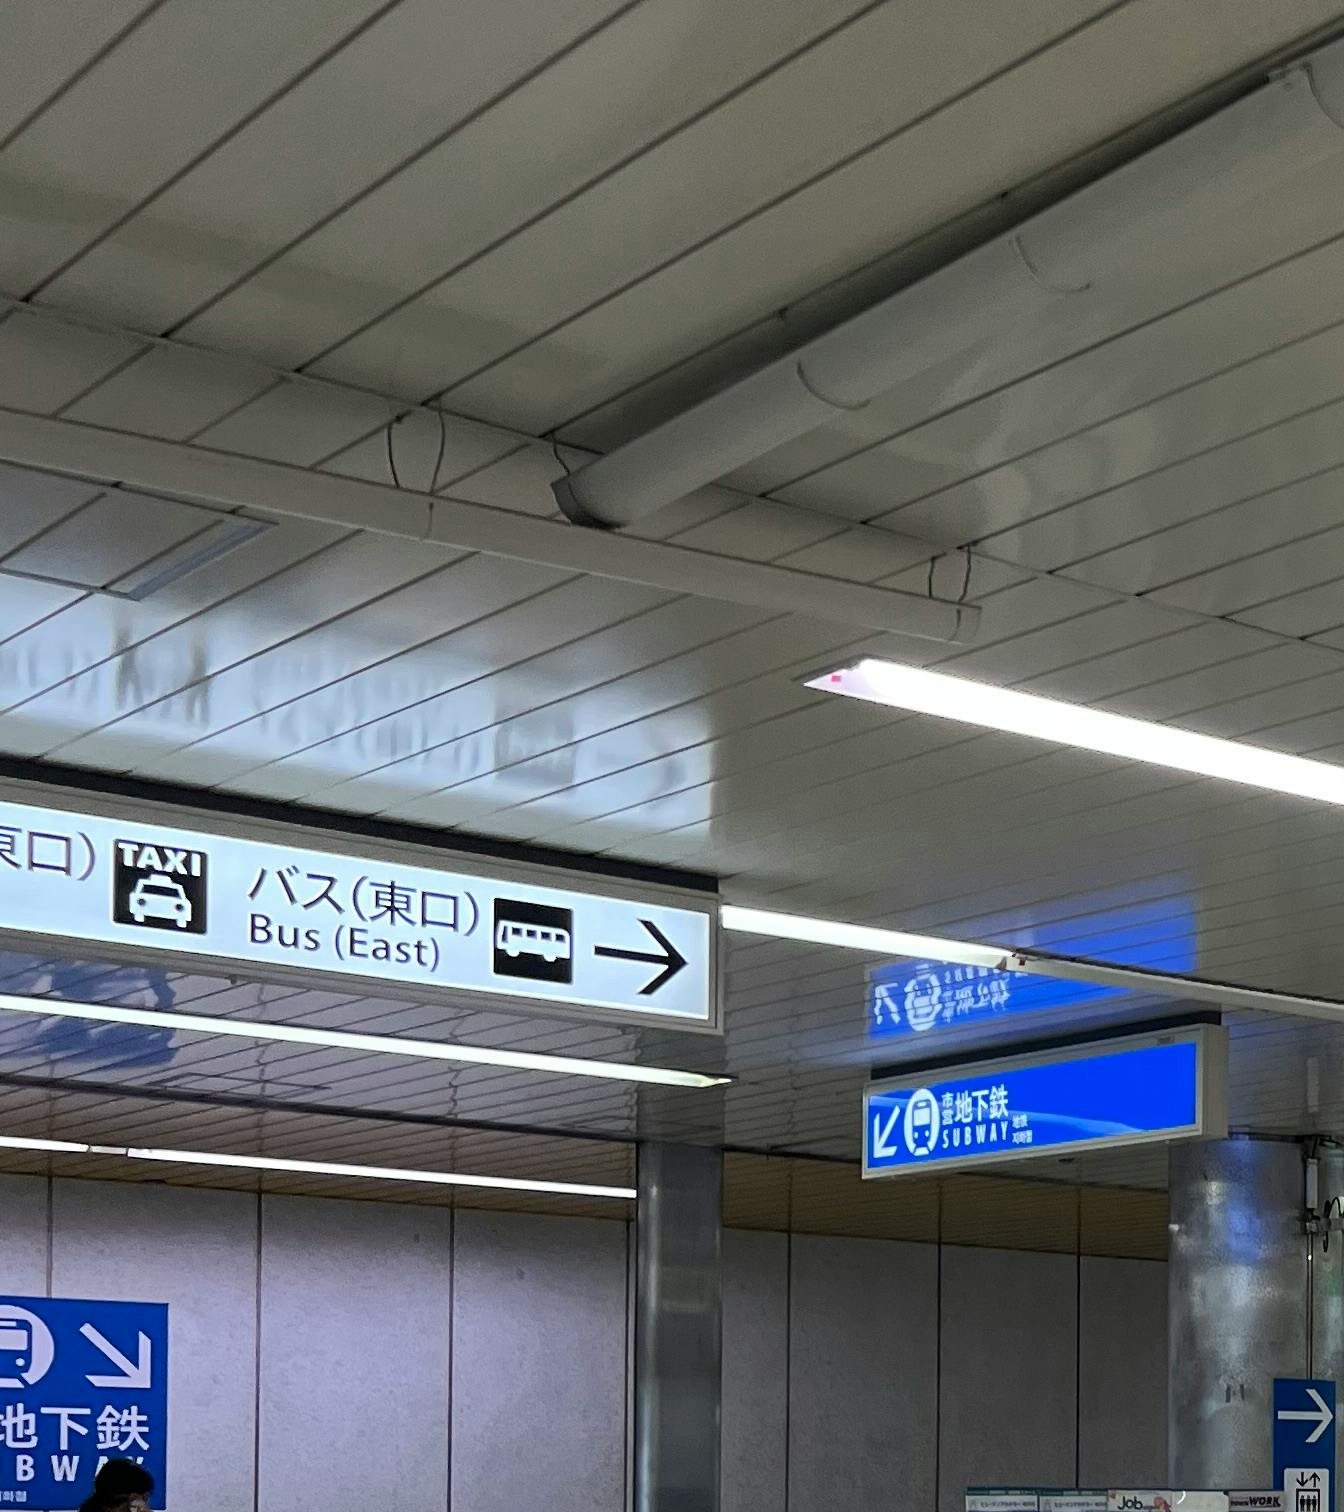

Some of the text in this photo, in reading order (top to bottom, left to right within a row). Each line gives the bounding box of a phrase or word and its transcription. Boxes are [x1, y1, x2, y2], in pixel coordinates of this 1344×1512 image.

[118, 842, 202, 877] TAXI
[248, 865, 480, 937] バス(東口)
[249, 913, 440, 973] Bus (East)
[954, 1084, 1009, 1124] 地下鉄
[942, 1121, 1009, 1149] SUBWAY
[1118, 1496, 1143, 1510] Job
